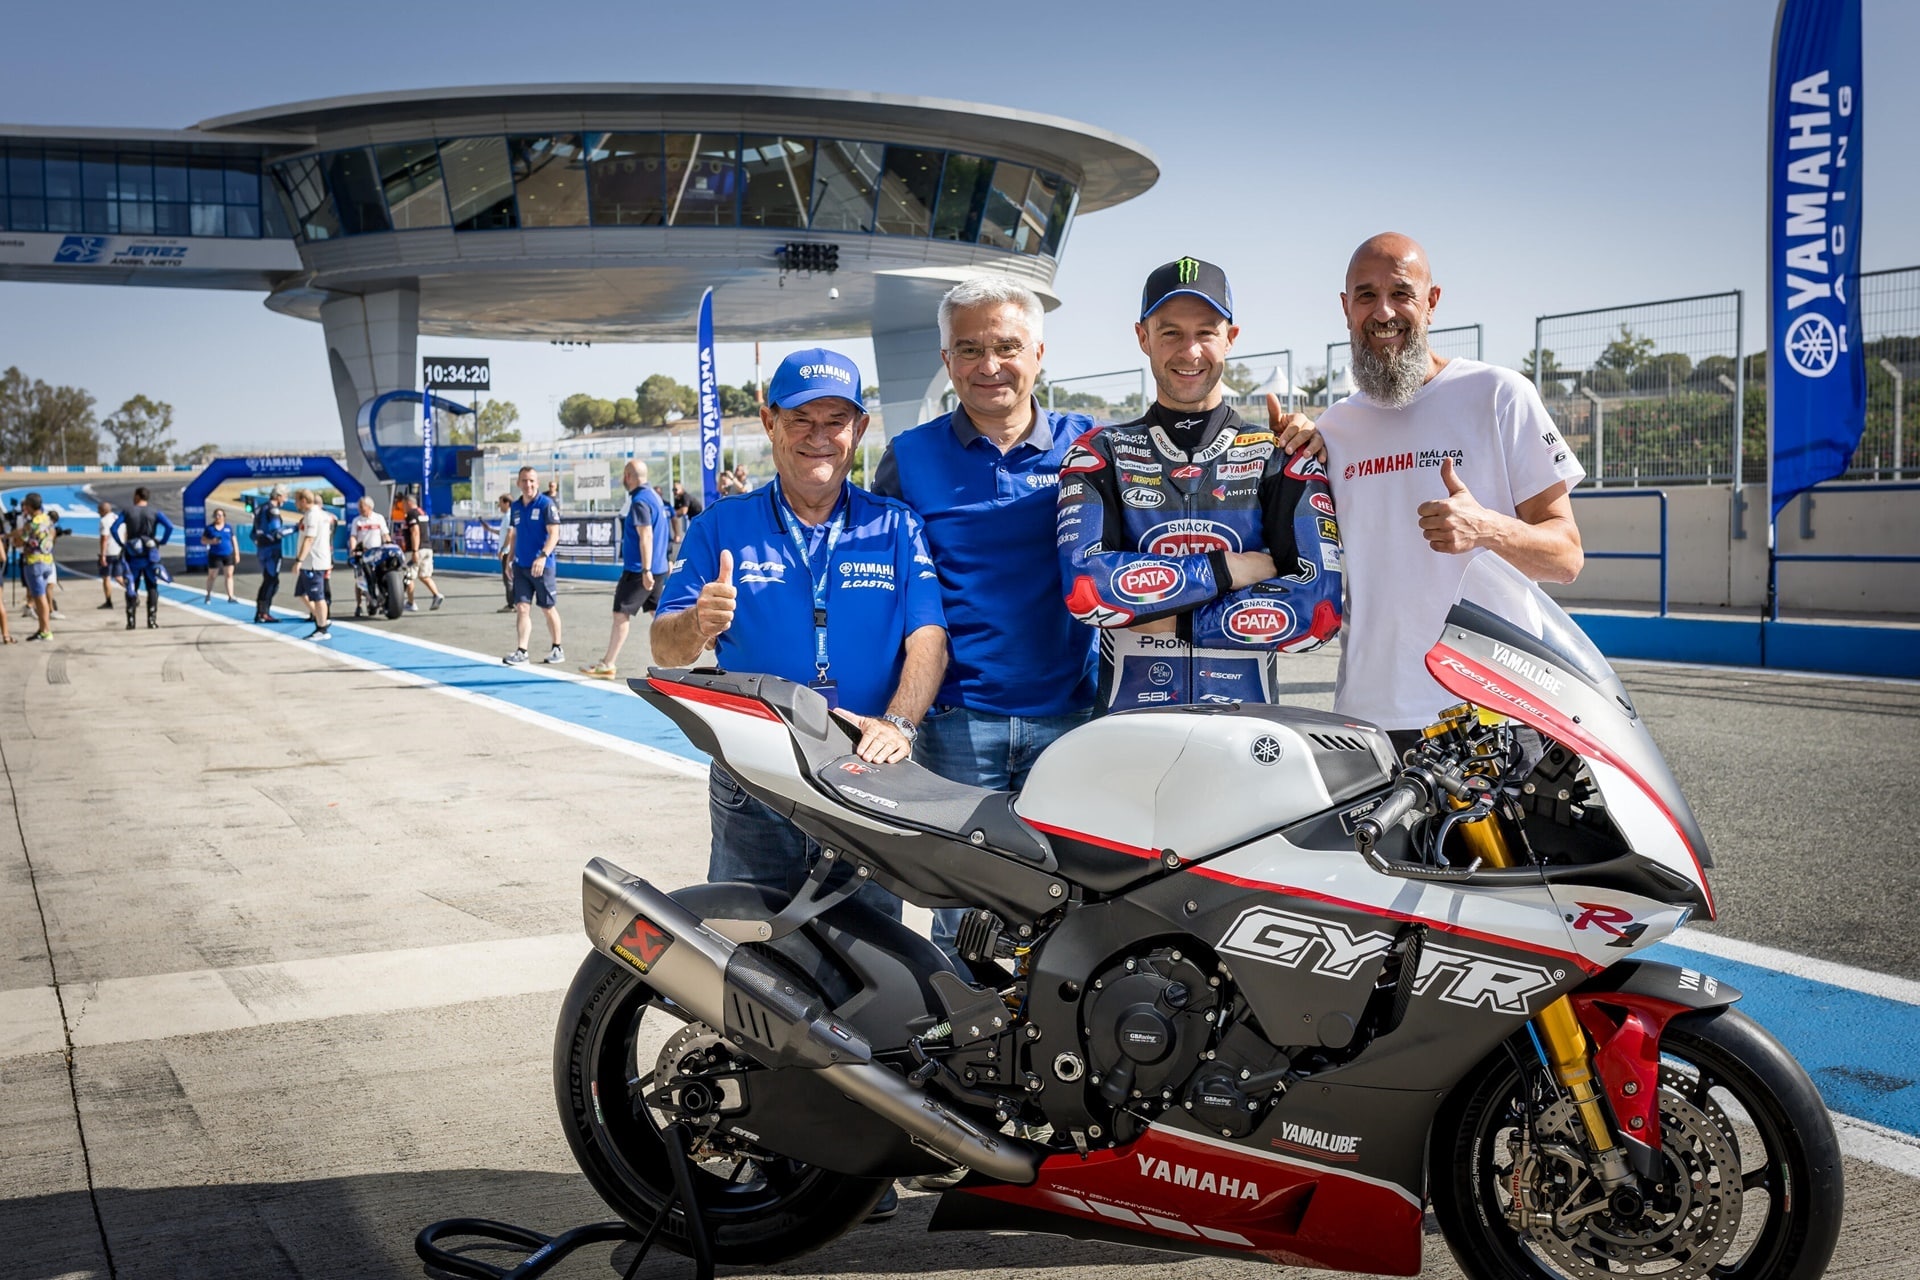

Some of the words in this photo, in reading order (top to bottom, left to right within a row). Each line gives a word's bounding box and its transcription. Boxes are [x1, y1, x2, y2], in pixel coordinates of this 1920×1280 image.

[1786, 69, 1831, 310] YAMAHA
[114, 245, 188, 258] JEREZ
[110, 257, 146, 266] ÁNGEL
[149, 258, 182, 267] NIETO
[424, 364, 489, 383] 10:34:20
[811, 365, 850, 383] YAMAHA
[1202, 433, 1230, 460] YAMAHA
[1230, 446, 1267, 458] Corpay
[1420, 449, 1463, 459] MÁLAGA
[260, 457, 303, 467] YAMAHA
[1230, 461, 1263, 474] YAMAHA
[1358, 452, 1414, 477] YAMAHA
[1419, 458, 1463, 468] CENR
[1126, 490, 1160, 502] Arai
[1169, 522, 1212, 533] SNACK
[1160, 543, 1217, 557] PATA
[1129, 561, 1160, 570] SNACK
[841, 580, 895, 591] E.CASTRO
[1126, 572, 1170, 590] PATA
[1243, 600, 1273, 609] SNACK
[1236, 613, 1280, 630] PATA
[1440, 655, 1486, 684] Revs
[1484, 680, 1515, 701] Your
[1491, 643, 1563, 697] YAMALUBE
[587, 971, 618, 1012] POWER
[570, 1021, 592, 1112] MICHELIN
[1281, 1121, 1357, 1154] YAMALUBE
[1136, 1152, 1260, 1201] YAMAHA
[1512, 1168, 1522, 1209] brembo
[1112, 1198, 1182, 1219] ANNIVERSARY
